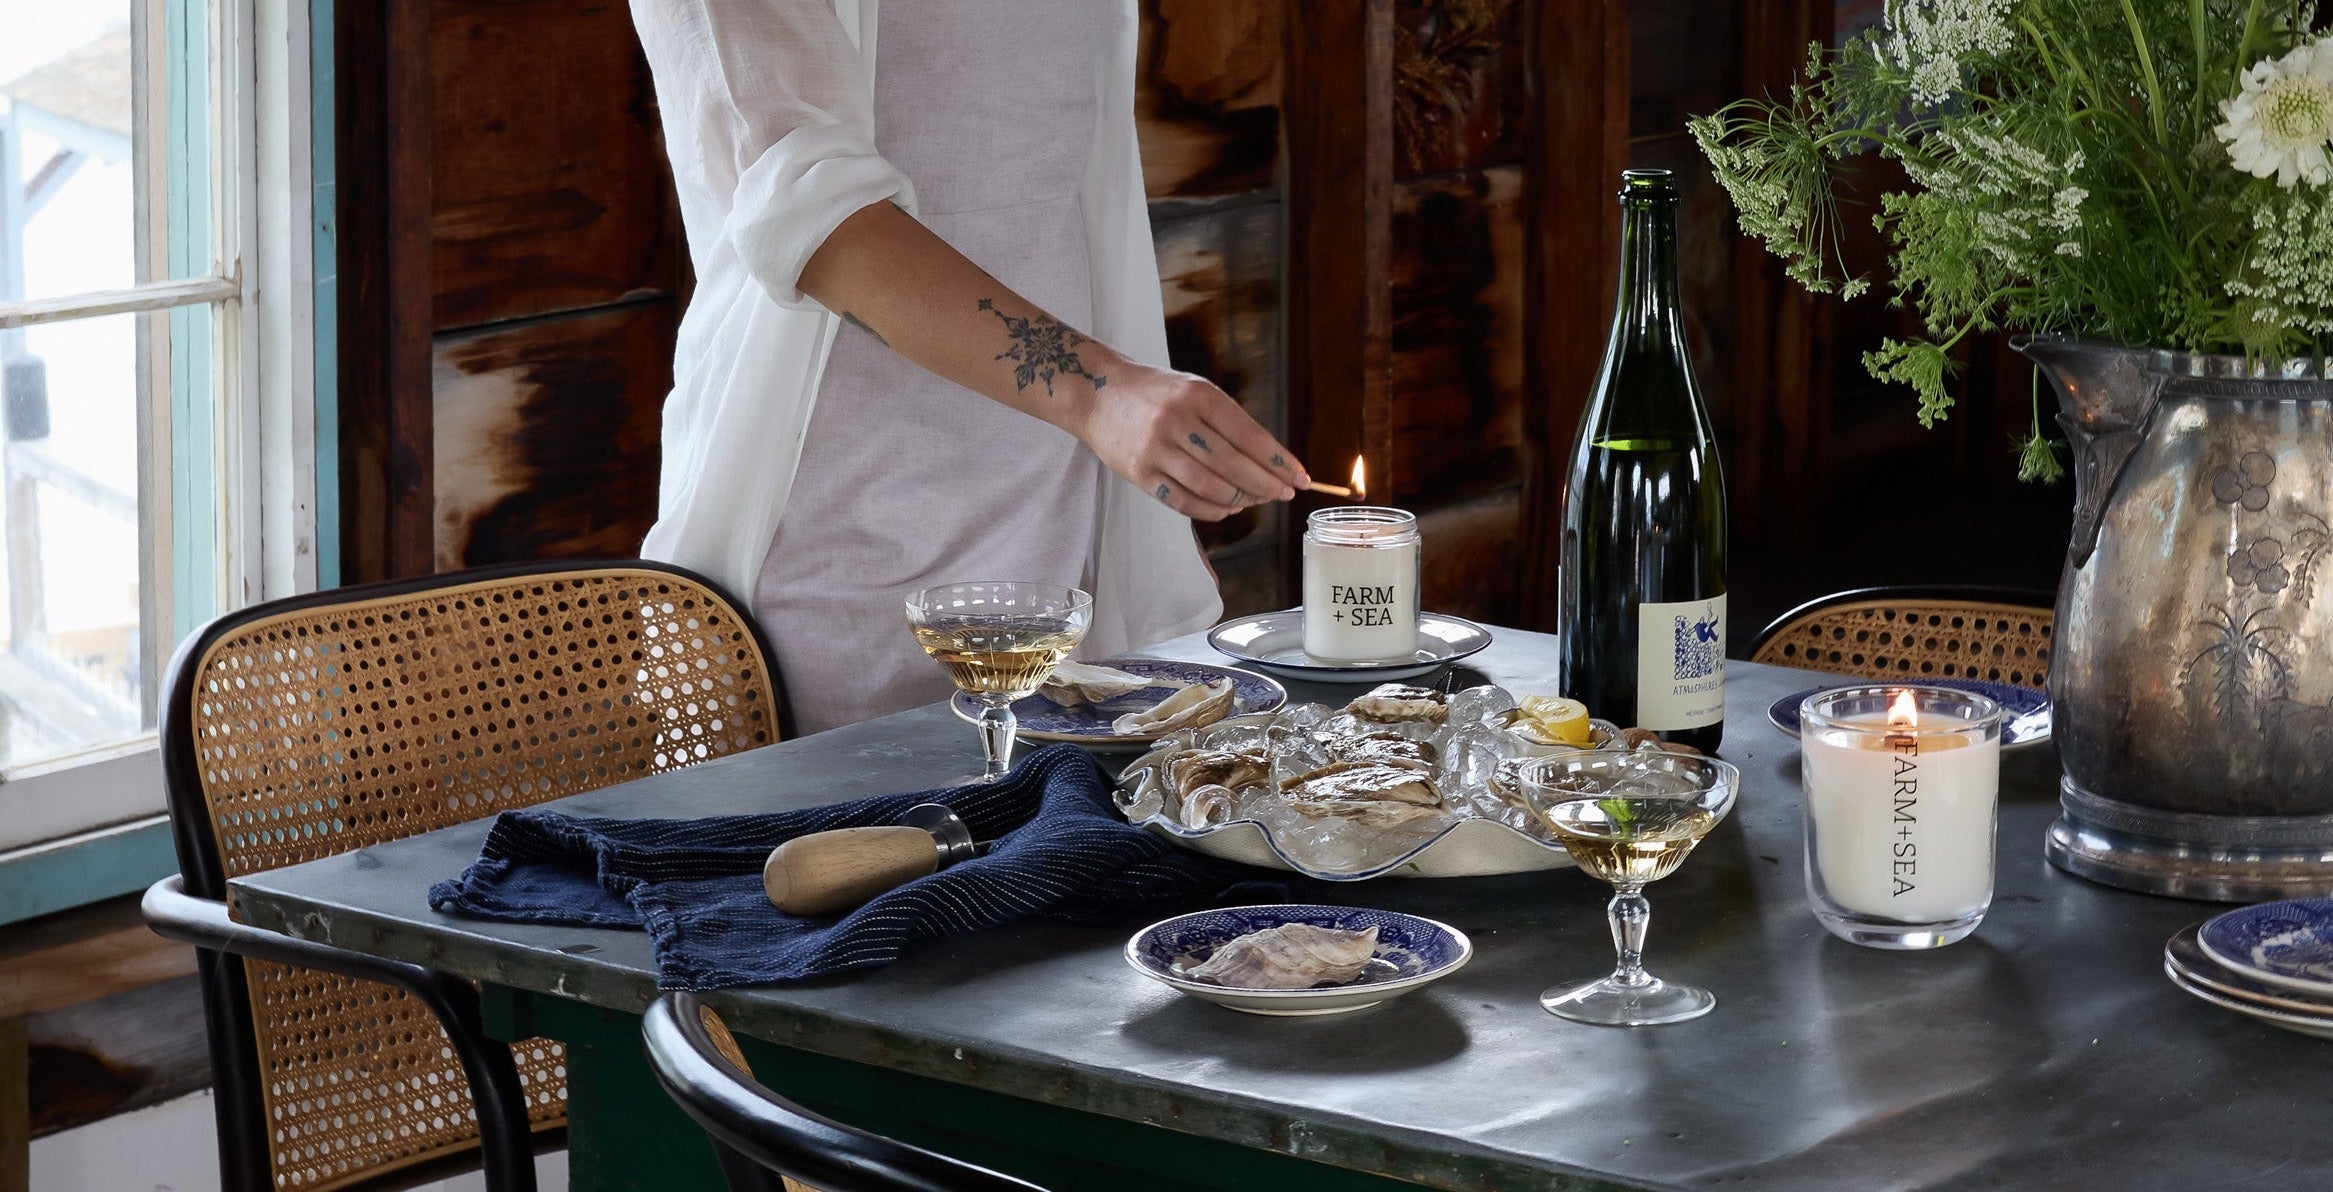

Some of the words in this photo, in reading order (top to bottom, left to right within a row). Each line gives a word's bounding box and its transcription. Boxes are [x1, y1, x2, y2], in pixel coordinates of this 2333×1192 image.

[1331, 585, 1395, 605] FARM
[1333, 610, 1345, 623] +
[1351, 607, 1394, 627] SEA
